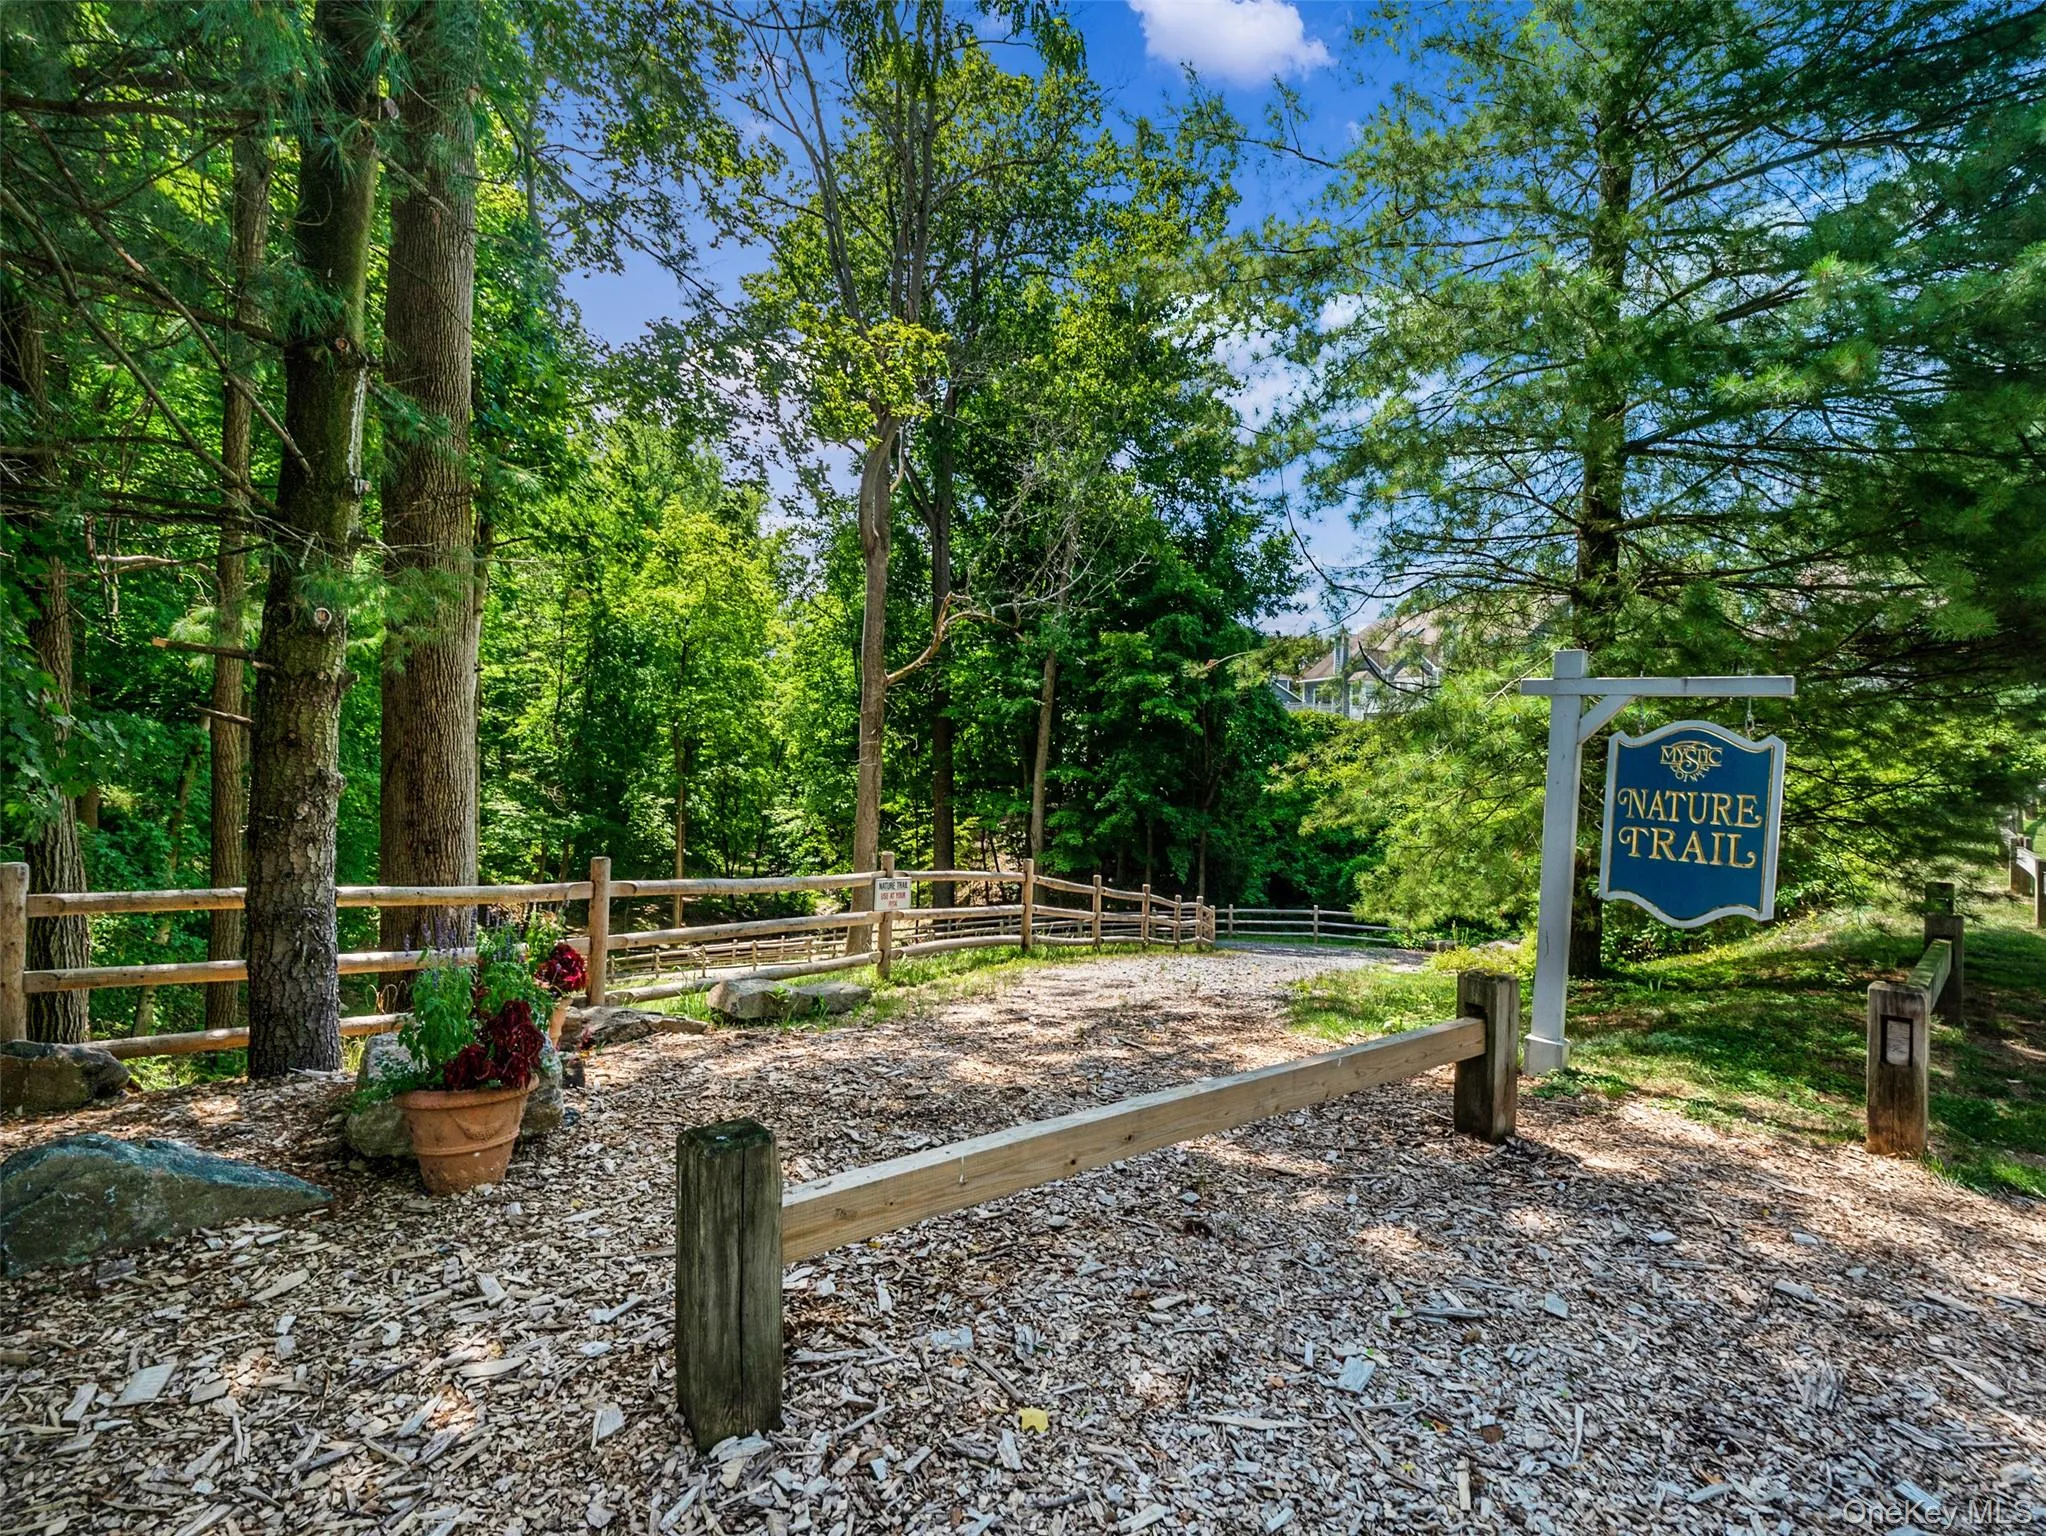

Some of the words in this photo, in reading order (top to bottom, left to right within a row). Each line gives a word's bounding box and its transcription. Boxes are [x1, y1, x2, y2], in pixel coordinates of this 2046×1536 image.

[1660, 745, 1722, 773] MYSTIC
[1617, 787, 1763, 828] NATURE
[1618, 826, 1757, 869] TRAIL
[879, 882, 895, 890] NATURE
[896, 881, 908, 889] TRAIL
